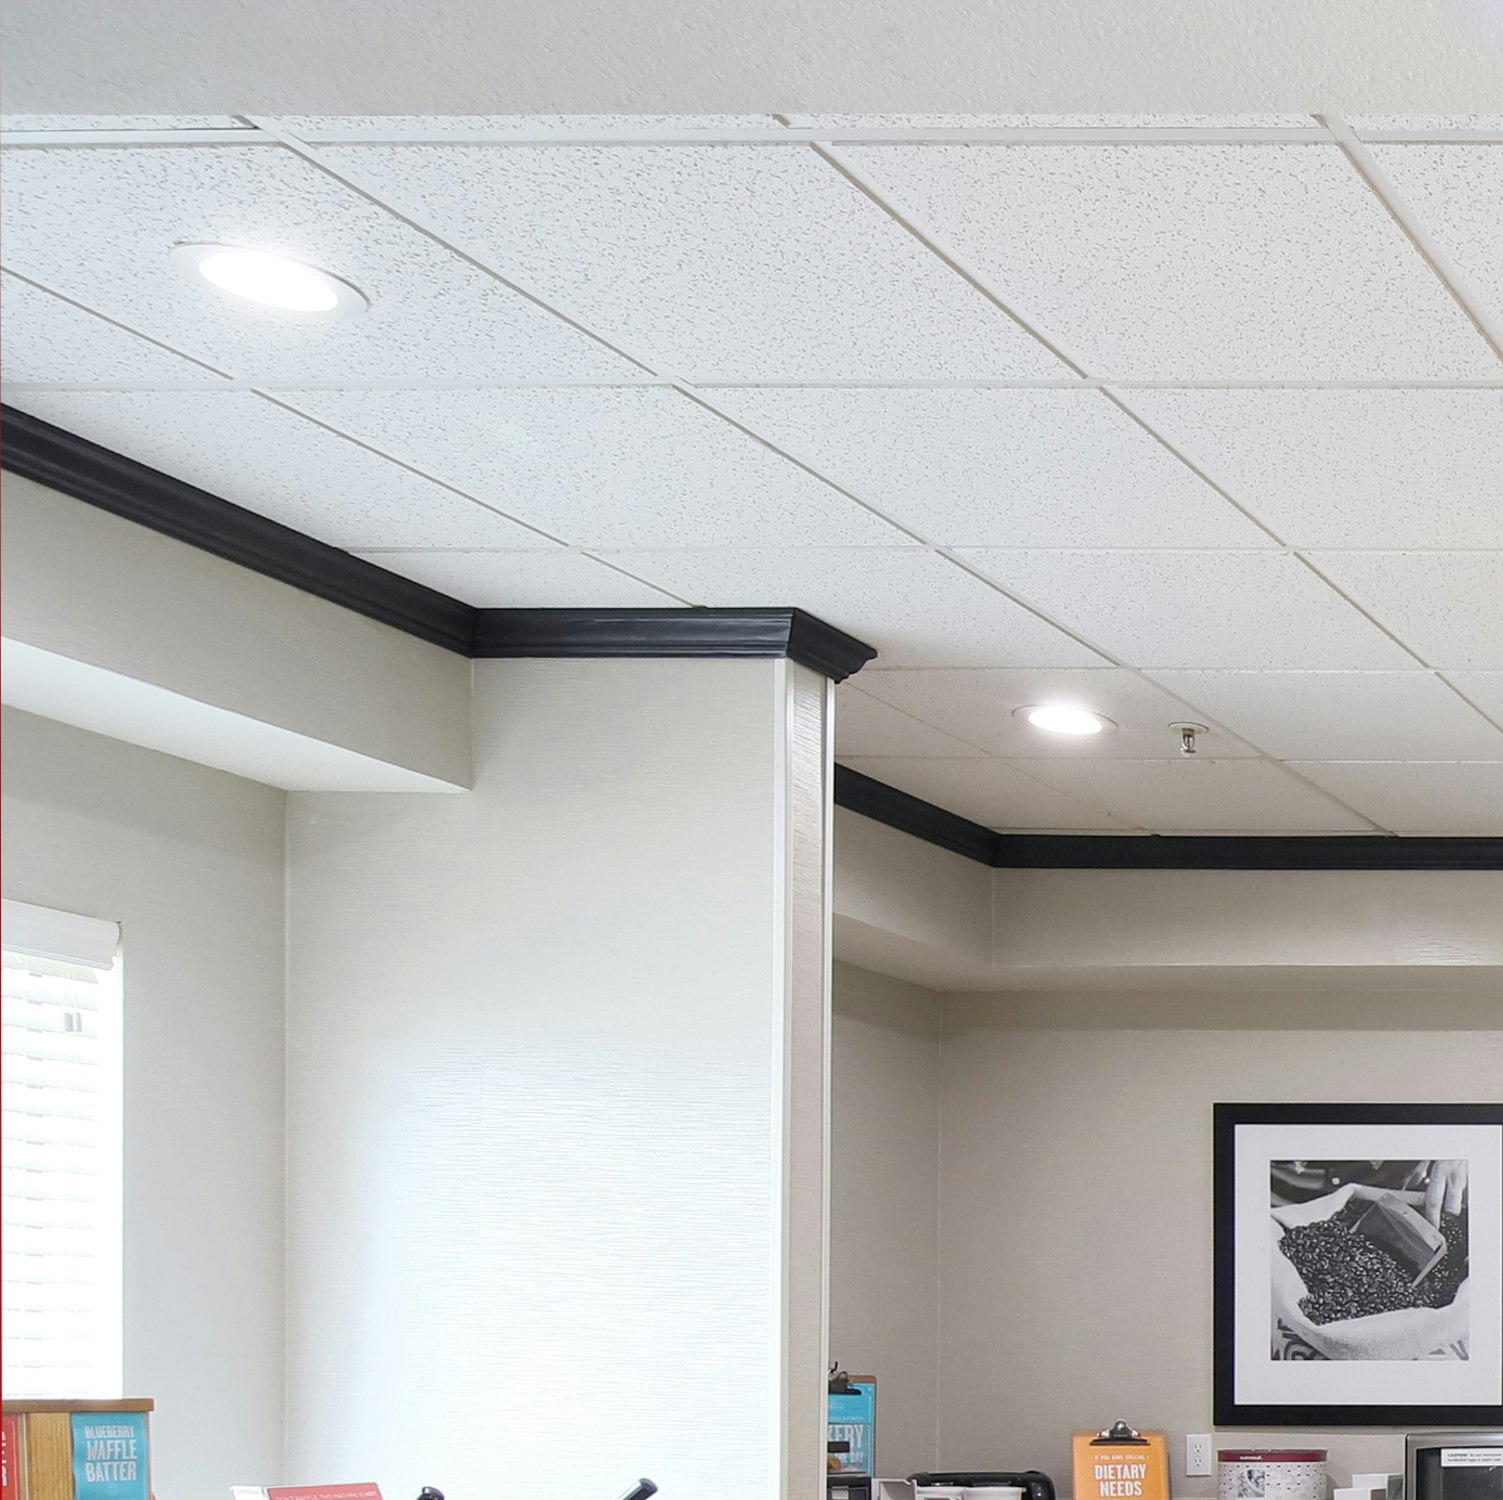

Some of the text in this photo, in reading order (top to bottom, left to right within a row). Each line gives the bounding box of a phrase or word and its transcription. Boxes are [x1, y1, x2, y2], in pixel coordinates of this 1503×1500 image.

[84, 1425, 134, 1439] BLUEBERRY
[86, 1439, 137, 1461] WAFFLE
[85, 1461, 137, 1482] BATTER
[1094, 1464, 1147, 1479] DIETARY
[1100, 1481, 1142, 1496] NEEDS
